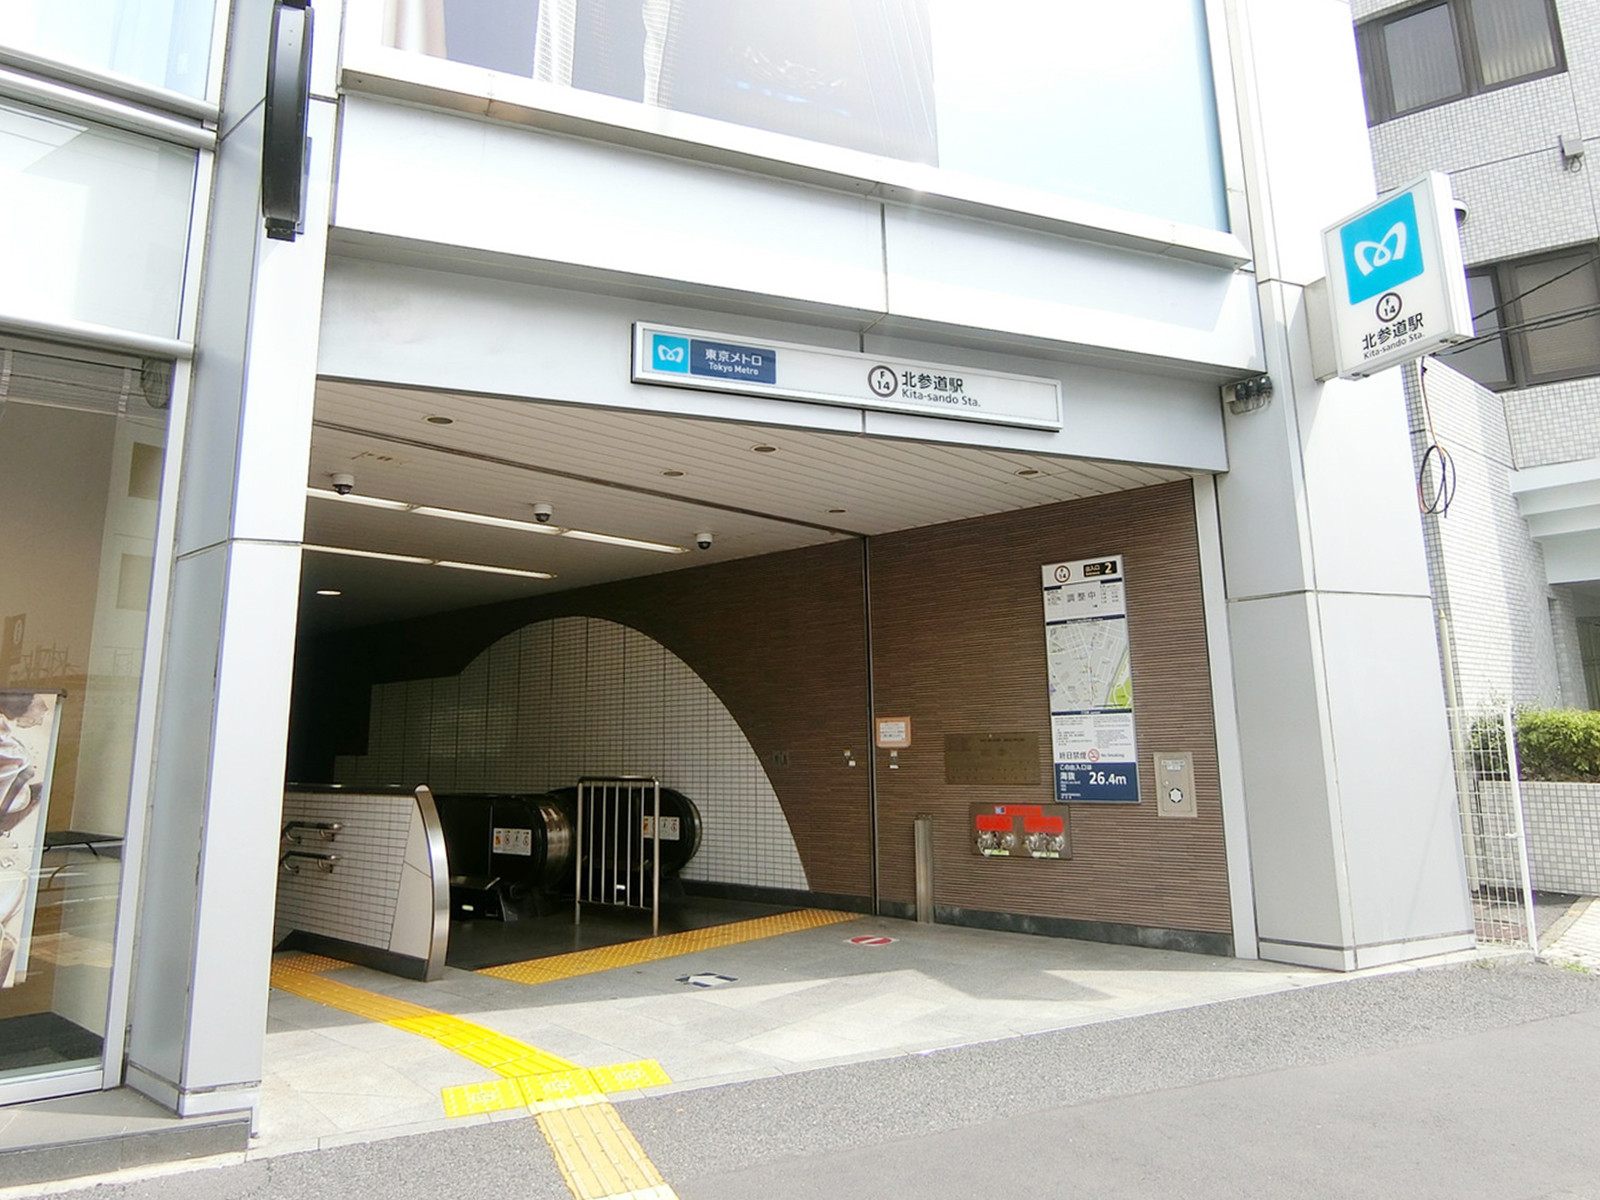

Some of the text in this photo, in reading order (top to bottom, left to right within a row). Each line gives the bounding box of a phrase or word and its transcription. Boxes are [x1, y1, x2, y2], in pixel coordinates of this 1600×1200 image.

[1384, 305, 1396, 316] 14
[1362, 312, 1424, 350] 北参道駅
[1363, 332, 1425, 360] Kita-sando Sta.
[705, 348, 763, 366] 東京メトロ
[708, 361, 759, 376] Tokyo Metro
[880, 371, 885, 379] F
[877, 381, 890, 390] 14
[901, 371, 964, 394] 北参道駅
[901, 389, 981, 407] Kita-sando Sta.
[1104, 562, 1112, 574] 2
[1058, 751, 1087, 760] 終日禁煙
[1088, 771, 1127, 785] 26.4m
